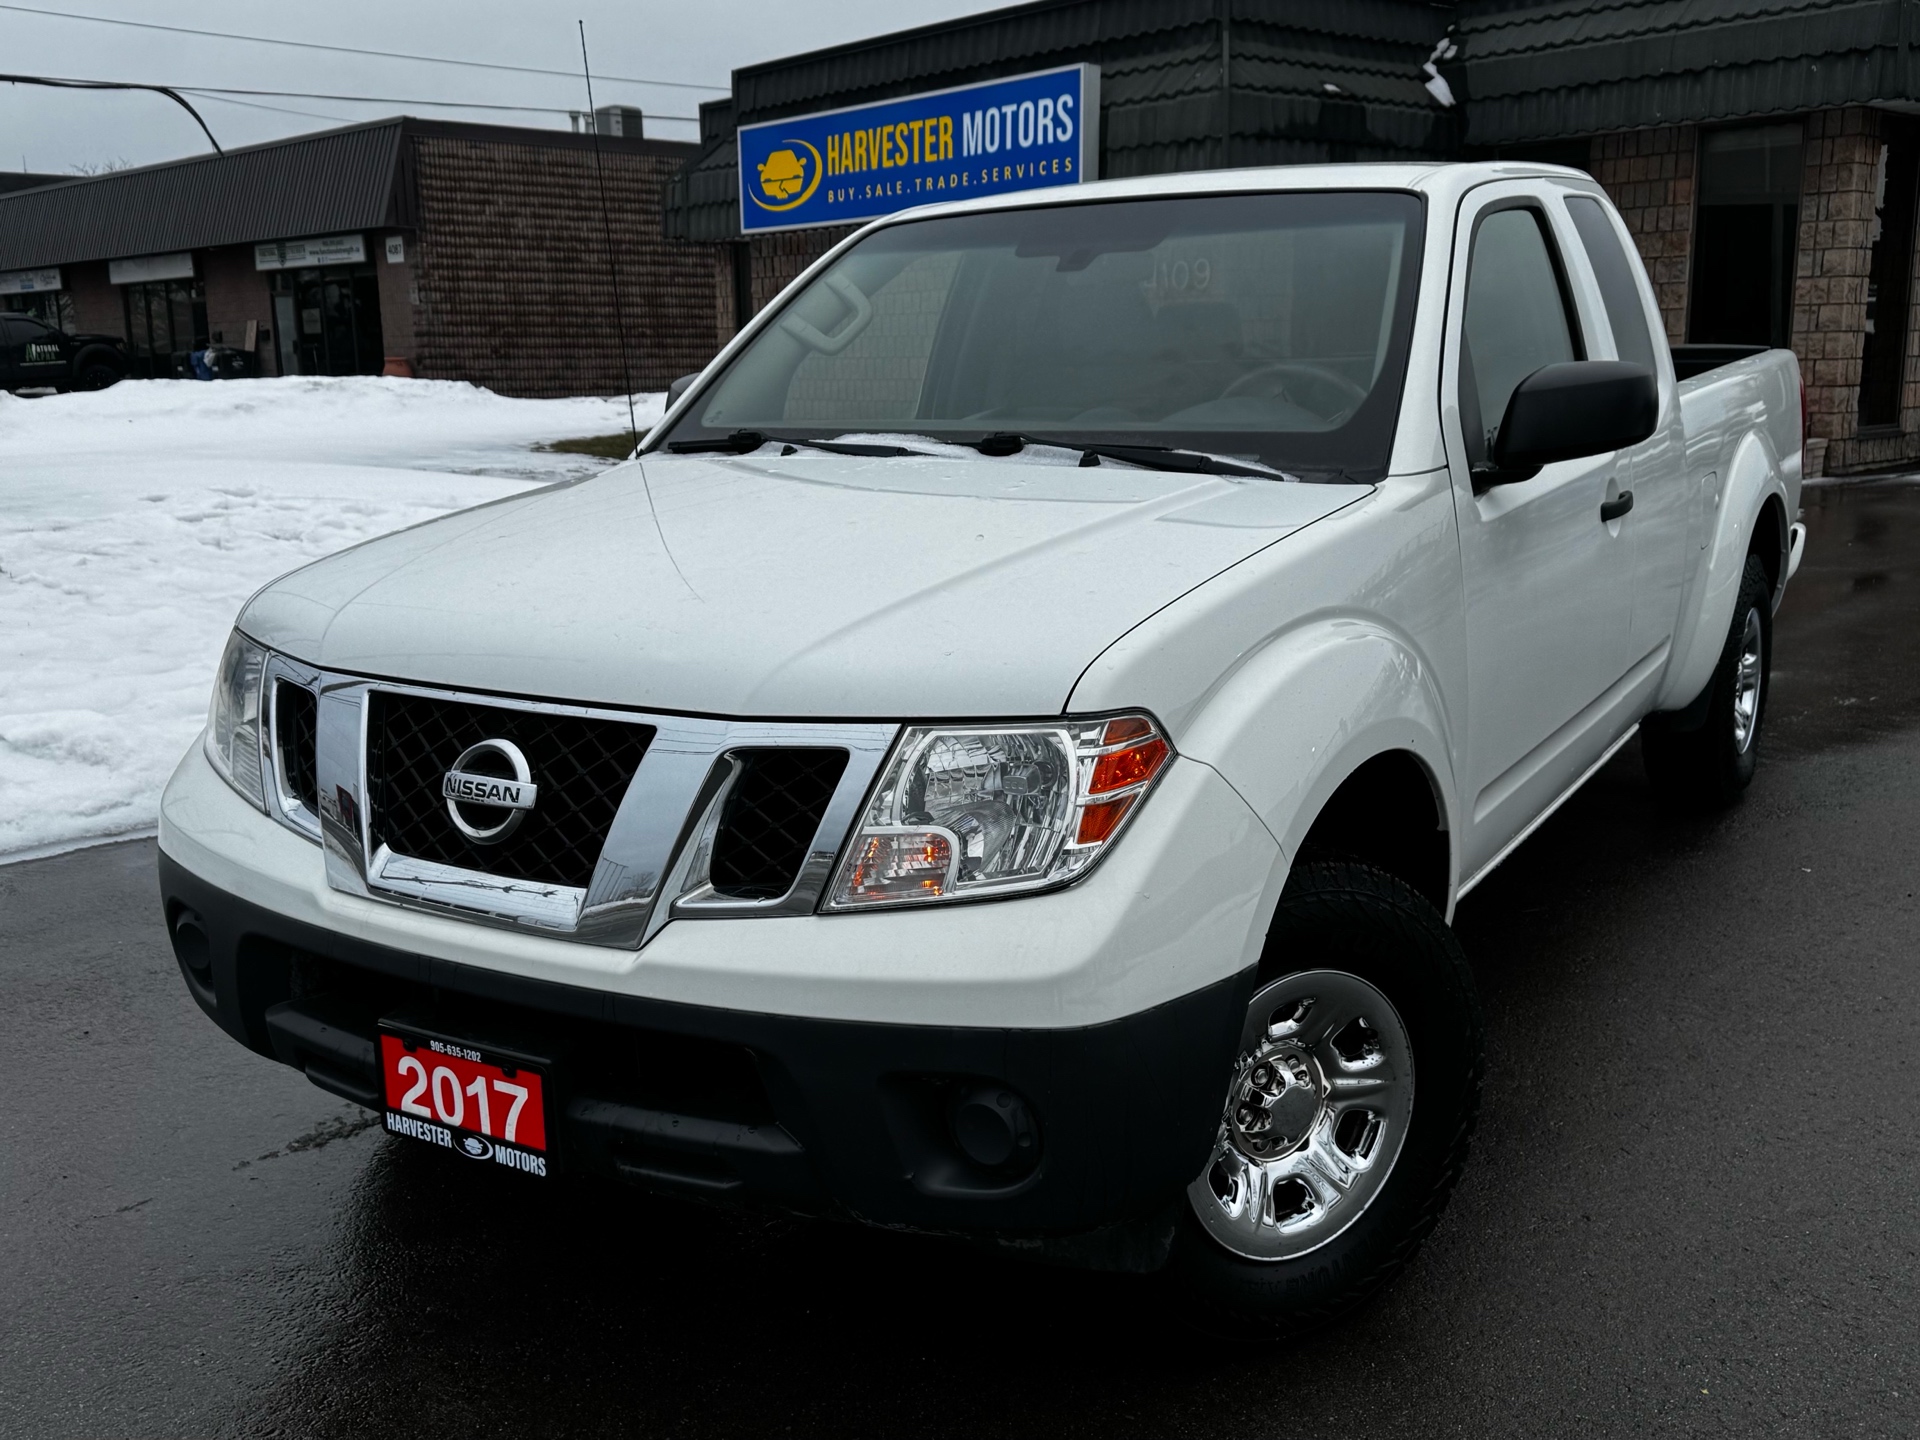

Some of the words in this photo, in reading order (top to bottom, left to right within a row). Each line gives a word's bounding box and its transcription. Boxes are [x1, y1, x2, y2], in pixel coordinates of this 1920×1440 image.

[827, 115, 953, 176] HARVESTER
[962, 93, 1074, 157] MOTORS
[444, 777, 521, 804] NISSAN
[430, 1040, 482, 1063] 905-635-1202
[397, 1055, 529, 1143] 2017
[386, 1111, 452, 1148] HARVESTER
[494, 1144, 547, 1177] MOTORS
